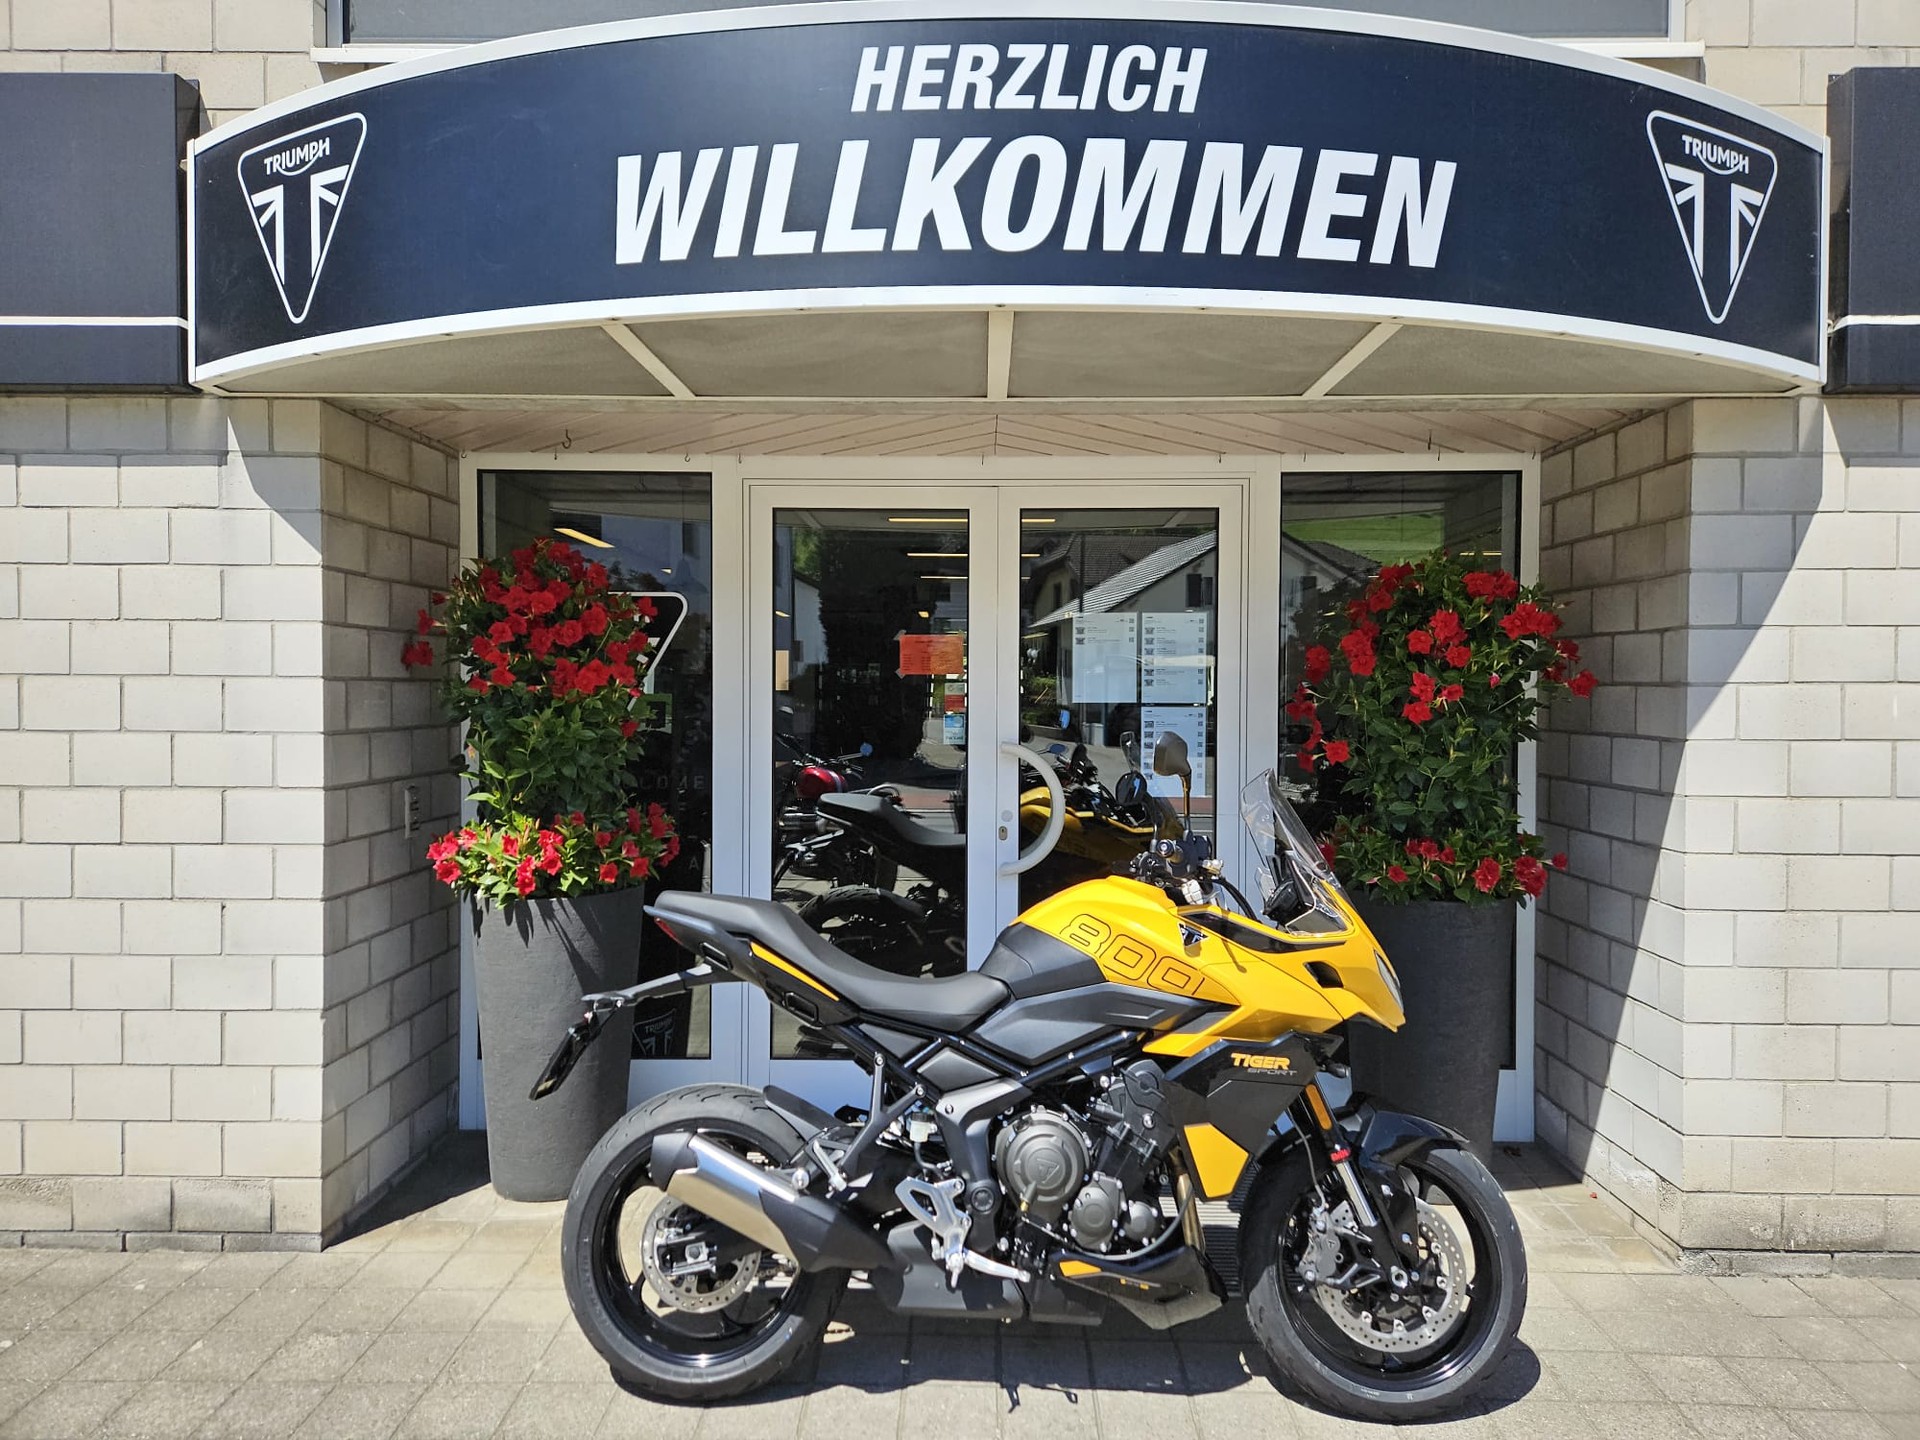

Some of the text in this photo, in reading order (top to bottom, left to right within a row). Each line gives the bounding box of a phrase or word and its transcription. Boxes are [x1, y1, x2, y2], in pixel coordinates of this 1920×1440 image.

[850, 43, 1208, 114] HERZLICH
[263, 136, 331, 176] TRIUMPH
[1681, 134, 1750, 175] TRIUMPH
[615, 135, 1457, 269] WILLKOMMEN
[1060, 913, 1206, 996] 800
[1230, 1052, 1291, 1070] TIGER
[1246, 1067, 1298, 1077] SPORT
